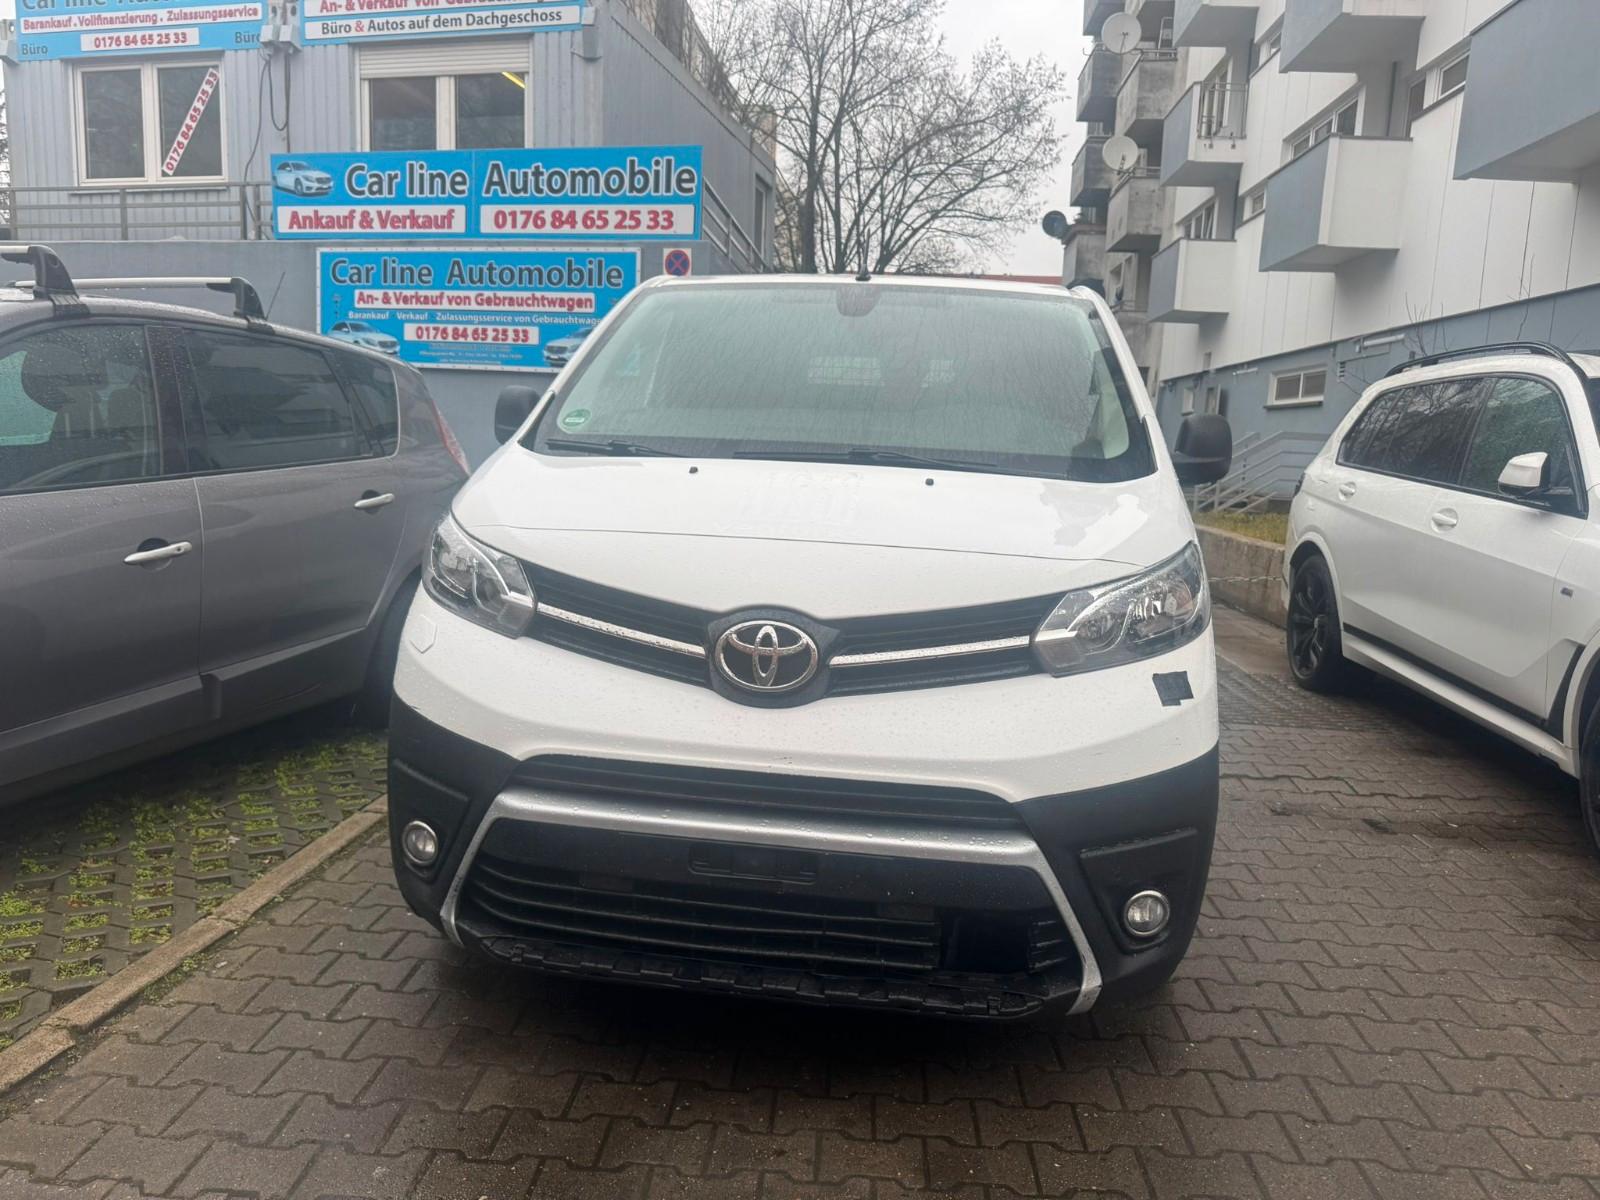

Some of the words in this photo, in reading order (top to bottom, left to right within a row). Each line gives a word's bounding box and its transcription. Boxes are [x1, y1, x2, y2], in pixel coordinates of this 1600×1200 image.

[23, 18, 72, 30] Barankauf
[78, 13, 158, 26] Vollfinanzierung
[166, 6, 258, 21] Zulassungsservice
[322, 22, 352, 34] Büro
[354, 20, 365, 32] &
[368, 20, 405, 32] Autos
[408, 16, 430, 29] auf
[433, 15, 462, 28] dem
[466, 10, 562, 27] Dachgeschoss
[22, 44, 48, 55] Büro
[94, 35, 122, 48] 0176
[124, 34, 138, 46] 84
[140, 34, 154, 46] 65
[157, 33, 170, 44] 25
[174, 32, 187, 44] 33
[166, 140, 184, 171] 0176
[180, 124, 193, 140] 84
[190, 105, 201, 122] 65
[197, 88, 210, 106] 25
[205, 72, 218, 88] 33
[346, 164, 399, 197] Car
[407, 162, 468, 196] line
[482, 157, 696, 196] Automobile
[288, 210, 355, 230] Ankauf
[360, 210, 374, 230] &
[376, 208, 455, 230] Verkauf
[494, 210, 546, 230] 0176
[550, 210, 578, 230] 84
[582, 210, 609, 230] 65
[614, 210, 642, 230] 25
[646, 210, 674, 230] 33
[330, 258, 376, 285] Car
[382, 257, 433, 286] line
[446, 258, 624, 288] Automobile
[356, 292, 378, 305] An-
[382, 292, 392, 305] &
[394, 292, 444, 306] Verkauf
[447, 295, 472, 306] von
[475, 293, 593, 311] Gebrauchtwagen
[348, 311, 390, 320] Barankauf
[396, 312, 428, 320] Verkauf
[436, 312, 512, 324] Zulassungsservice
[416, 326, 449, 340] 0176
[452, 327, 470, 341] 84
[472, 328, 488, 342] 65
[492, 328, 509, 342] 25
[512, 329, 529, 343] 33
